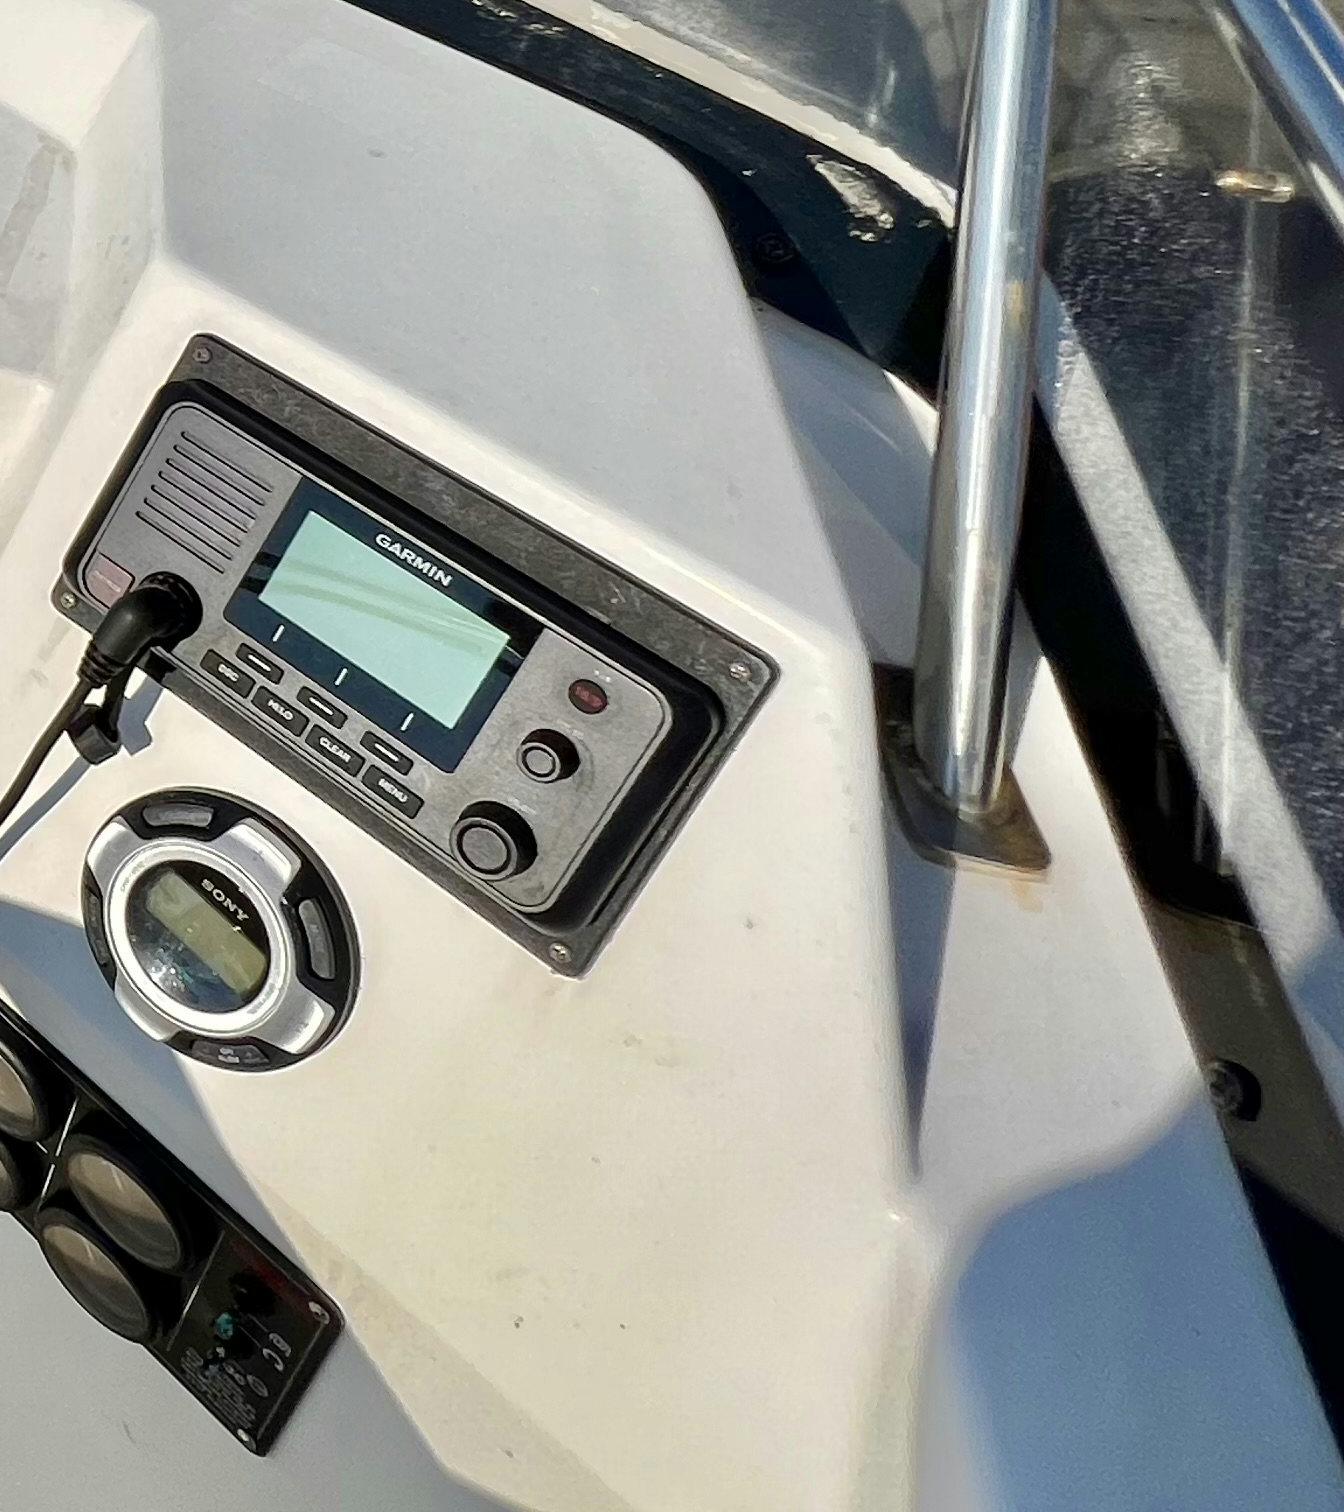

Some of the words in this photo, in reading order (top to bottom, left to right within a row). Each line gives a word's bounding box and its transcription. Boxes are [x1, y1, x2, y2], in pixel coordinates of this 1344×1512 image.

[375, 533, 453, 587] GARMIN
[319, 736, 352, 764] CLEAR
[377, 777, 409, 804] MENU
[200, 877, 250, 922] SONY
